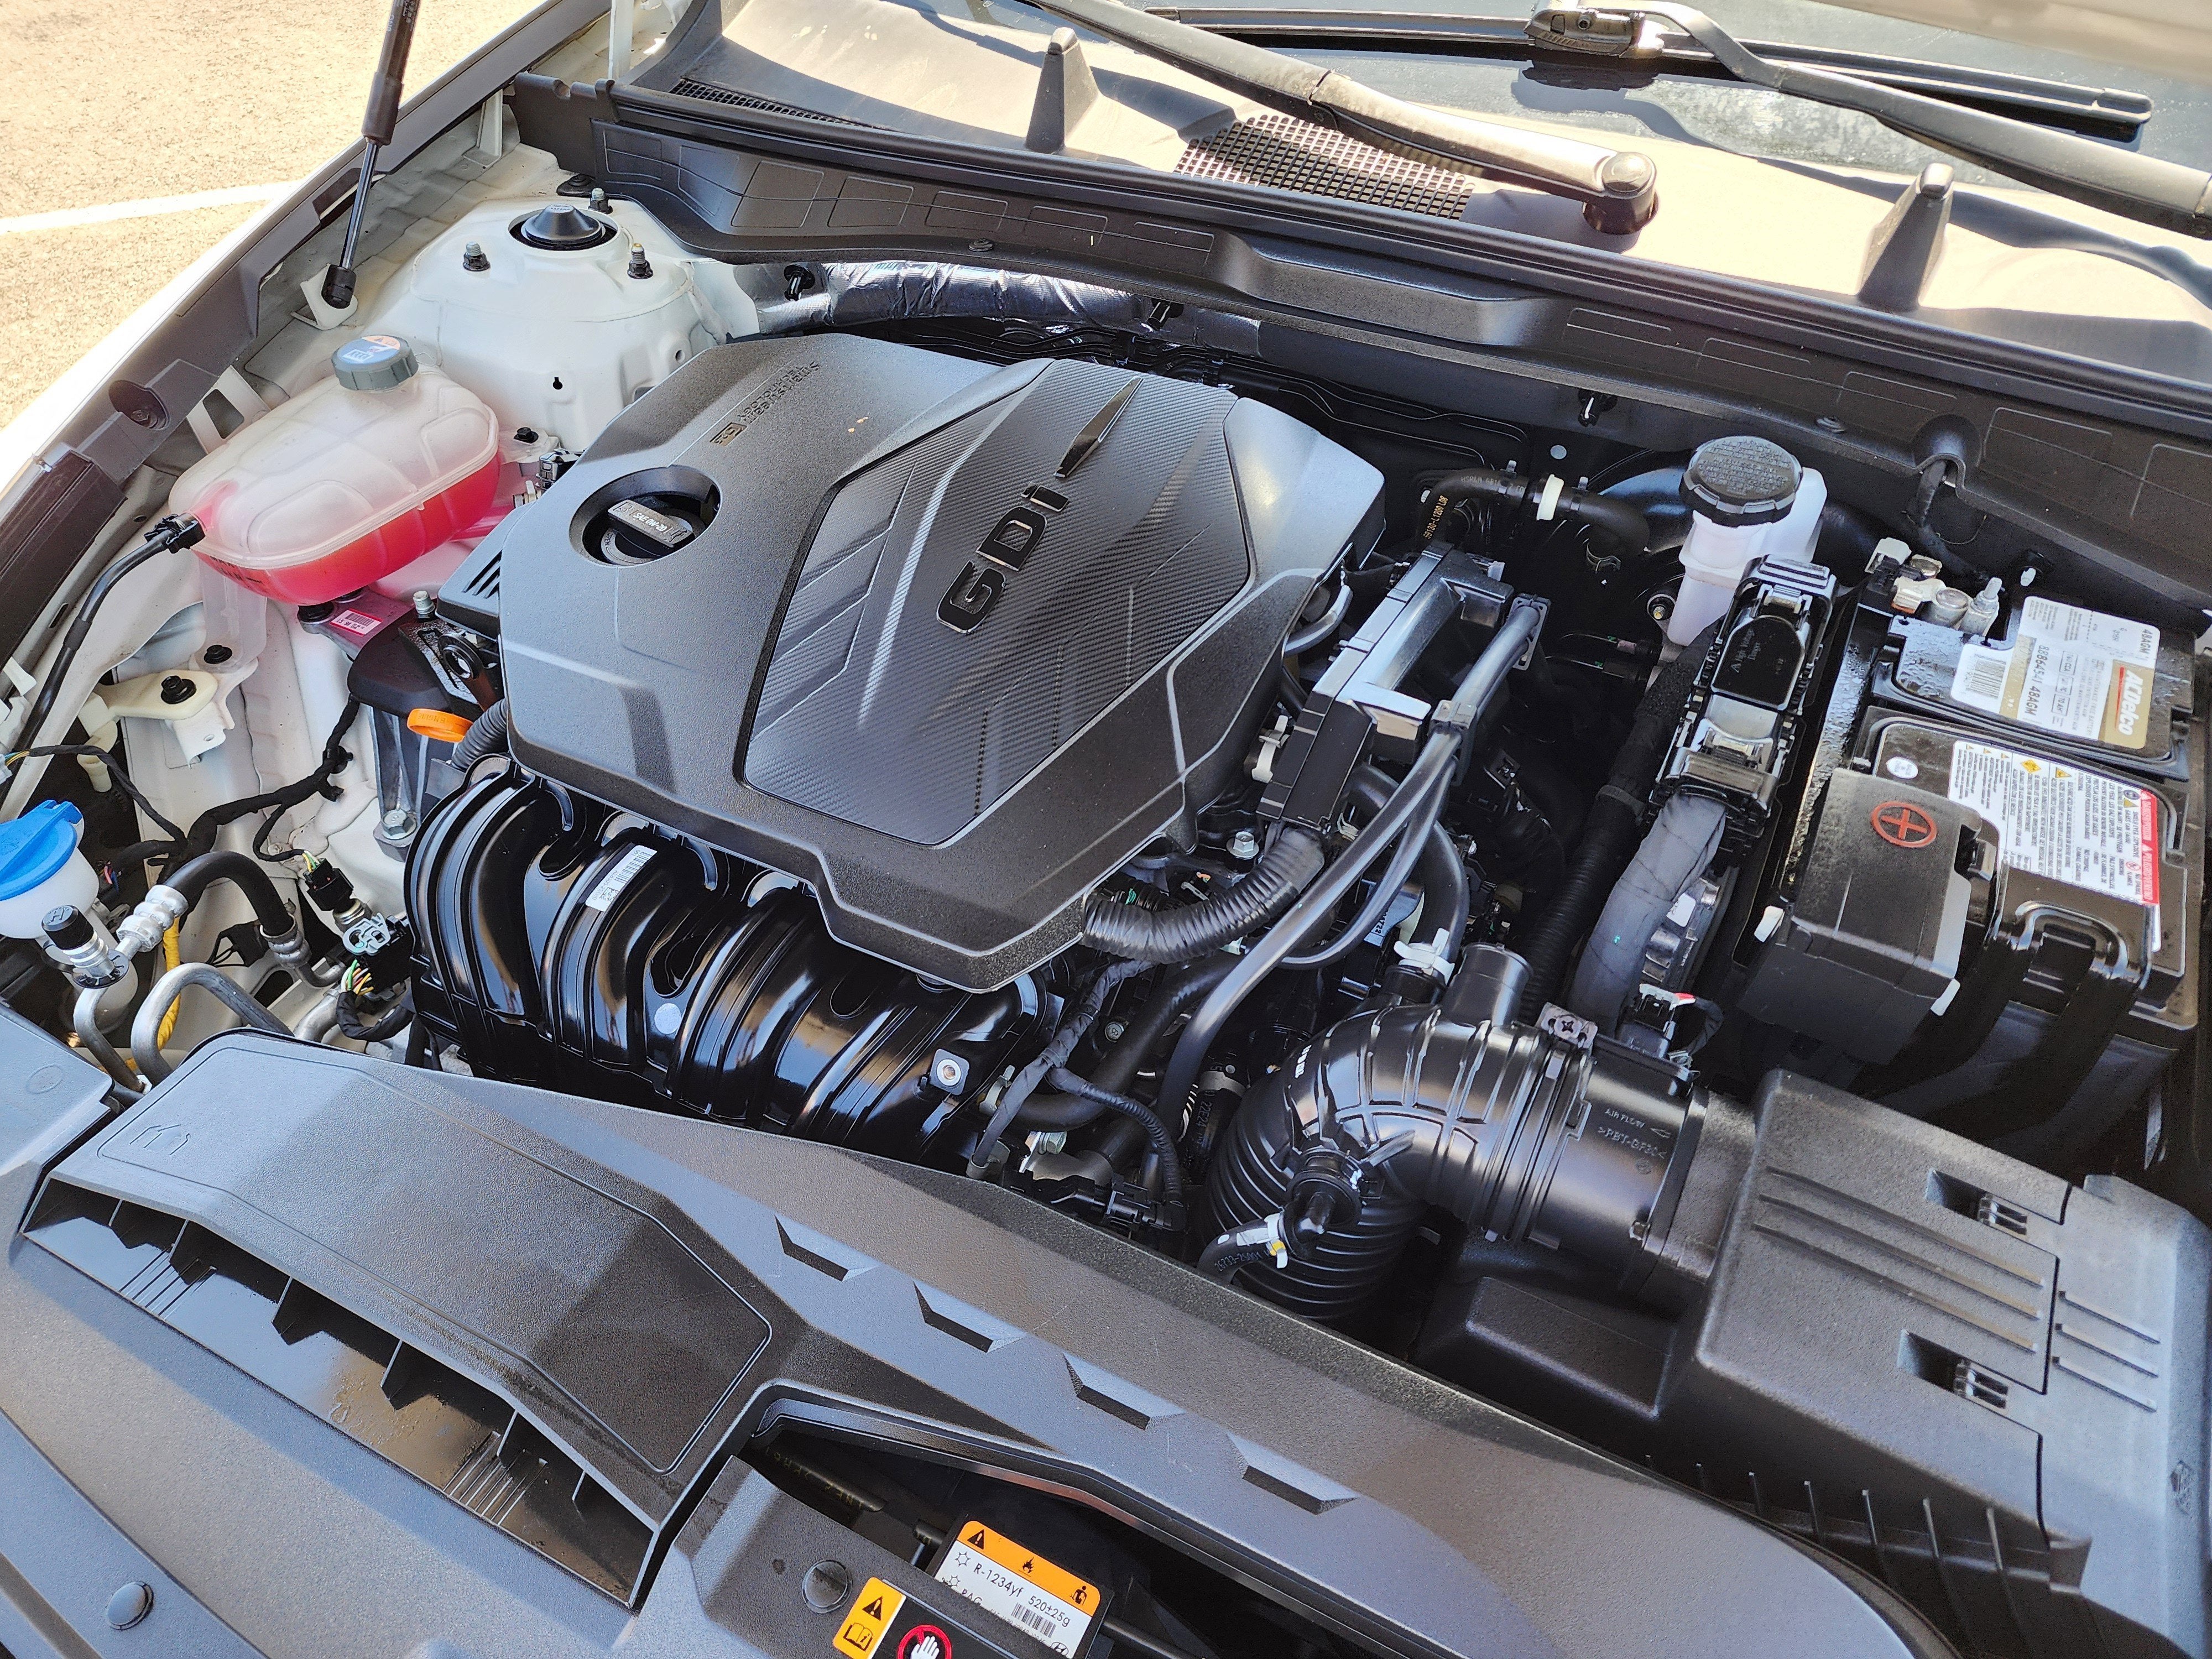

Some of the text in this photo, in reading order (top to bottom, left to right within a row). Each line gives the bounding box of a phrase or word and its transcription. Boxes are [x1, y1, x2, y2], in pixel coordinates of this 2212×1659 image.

[633, 512, 667, 531] SAE 0W-20
[935, 481, 1070, 634] GDi
[2139, 629, 2153, 654] 48AGM
[2026, 686, 2041, 716] 48AGM
[2118, 670, 2143, 735] ACDelco
[973, 1563, 1024, 1598] R-1234yf
[1028, 1595, 1071, 1627] 520±25g
